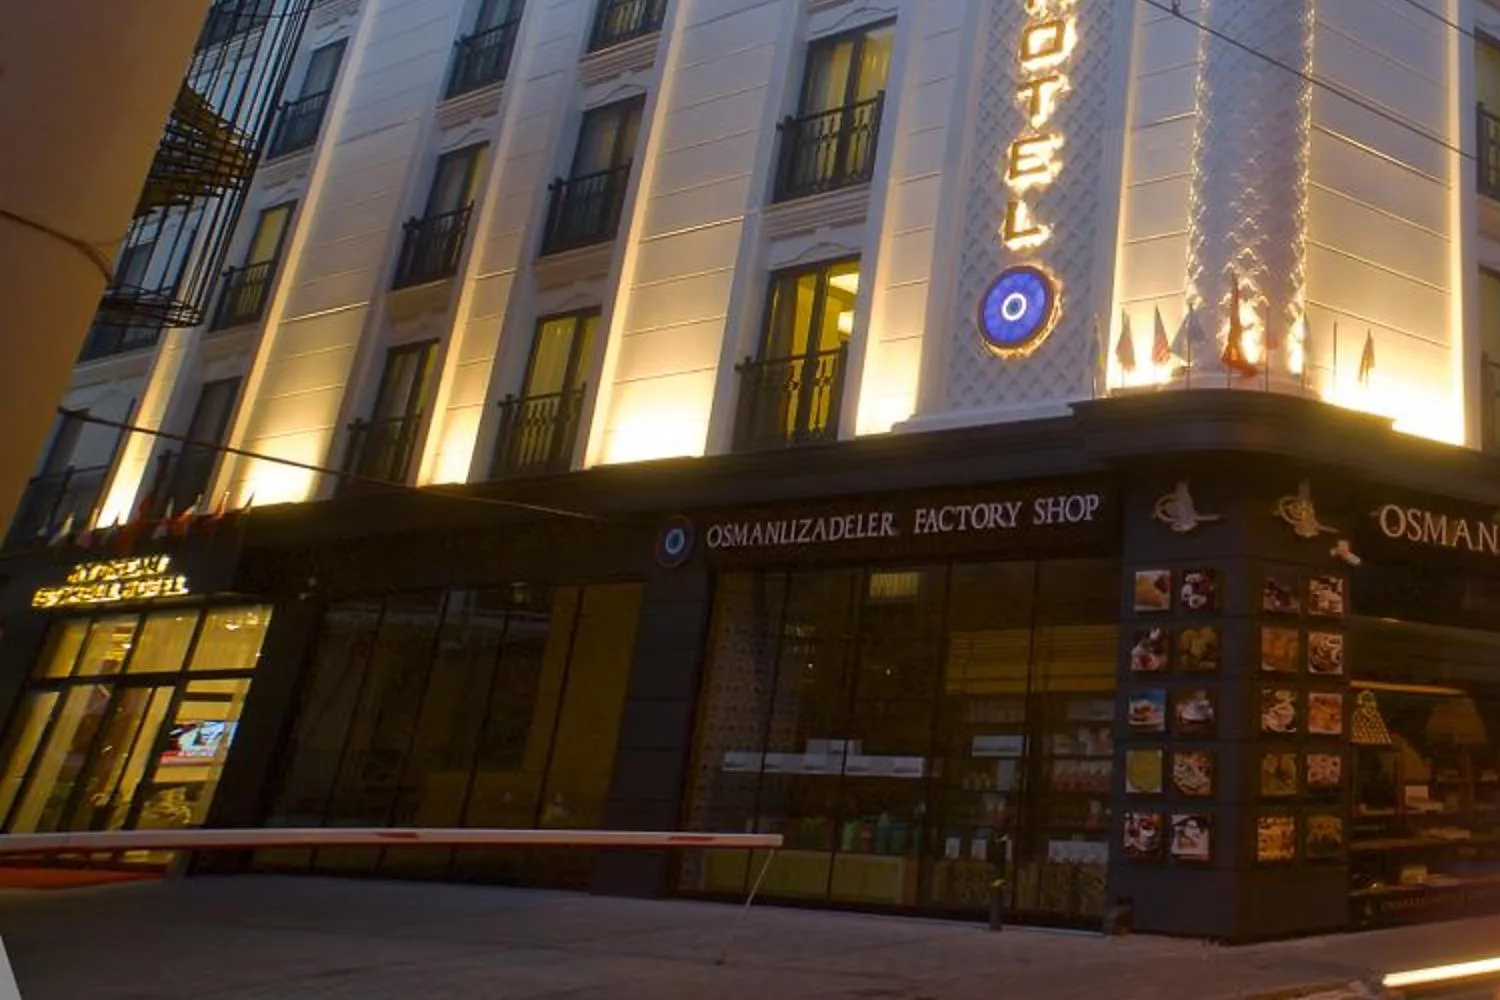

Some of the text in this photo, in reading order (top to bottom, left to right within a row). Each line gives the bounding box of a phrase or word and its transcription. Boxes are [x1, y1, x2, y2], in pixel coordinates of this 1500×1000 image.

[706, 494, 1100, 550] OSMANLIZADELER FACTORY SHOP
